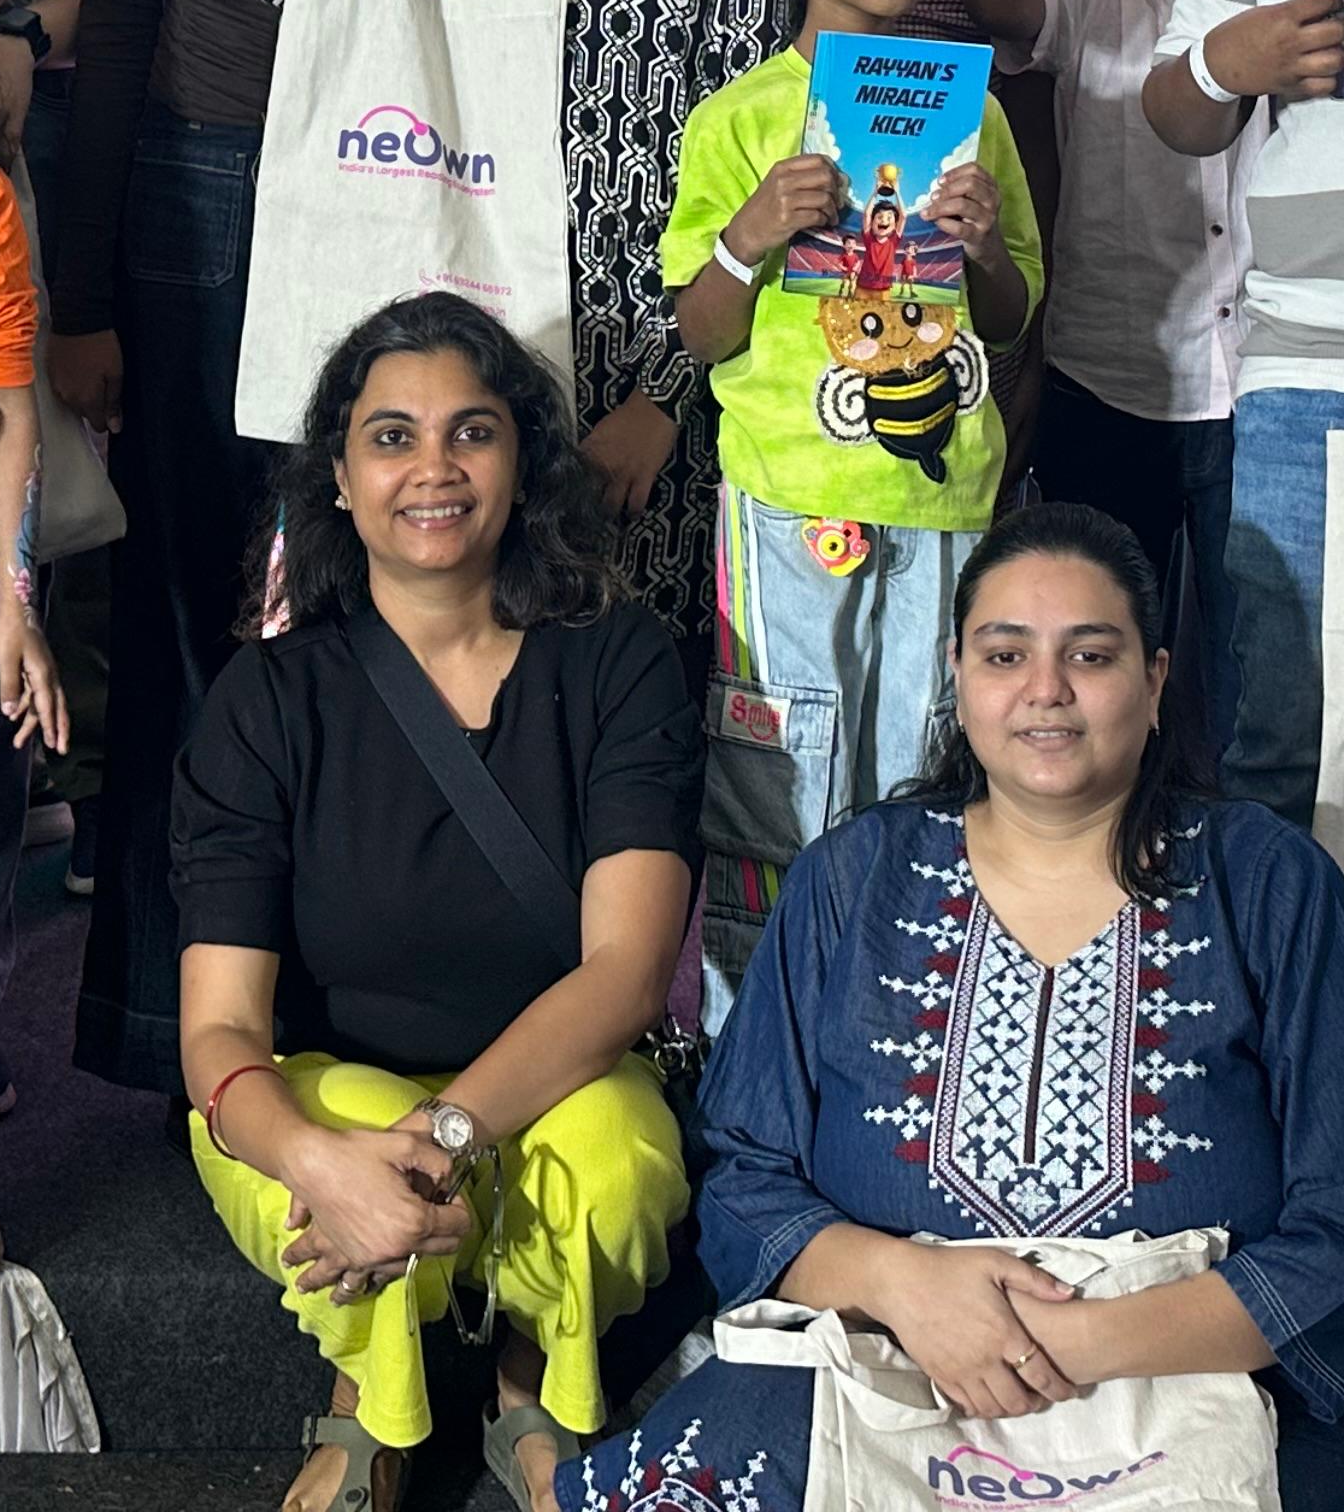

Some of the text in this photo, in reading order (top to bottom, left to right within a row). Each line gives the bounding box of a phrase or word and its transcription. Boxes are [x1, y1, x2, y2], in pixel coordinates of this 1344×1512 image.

[852, 55, 959, 83] RAYYAN'S
[854, 84, 949, 111] MIRACLE
[869, 114, 927, 137] KICK!
[337, 123, 495, 184] neOwn
[376, 165, 416, 179] Largest
[730, 693, 781, 730] Smile
